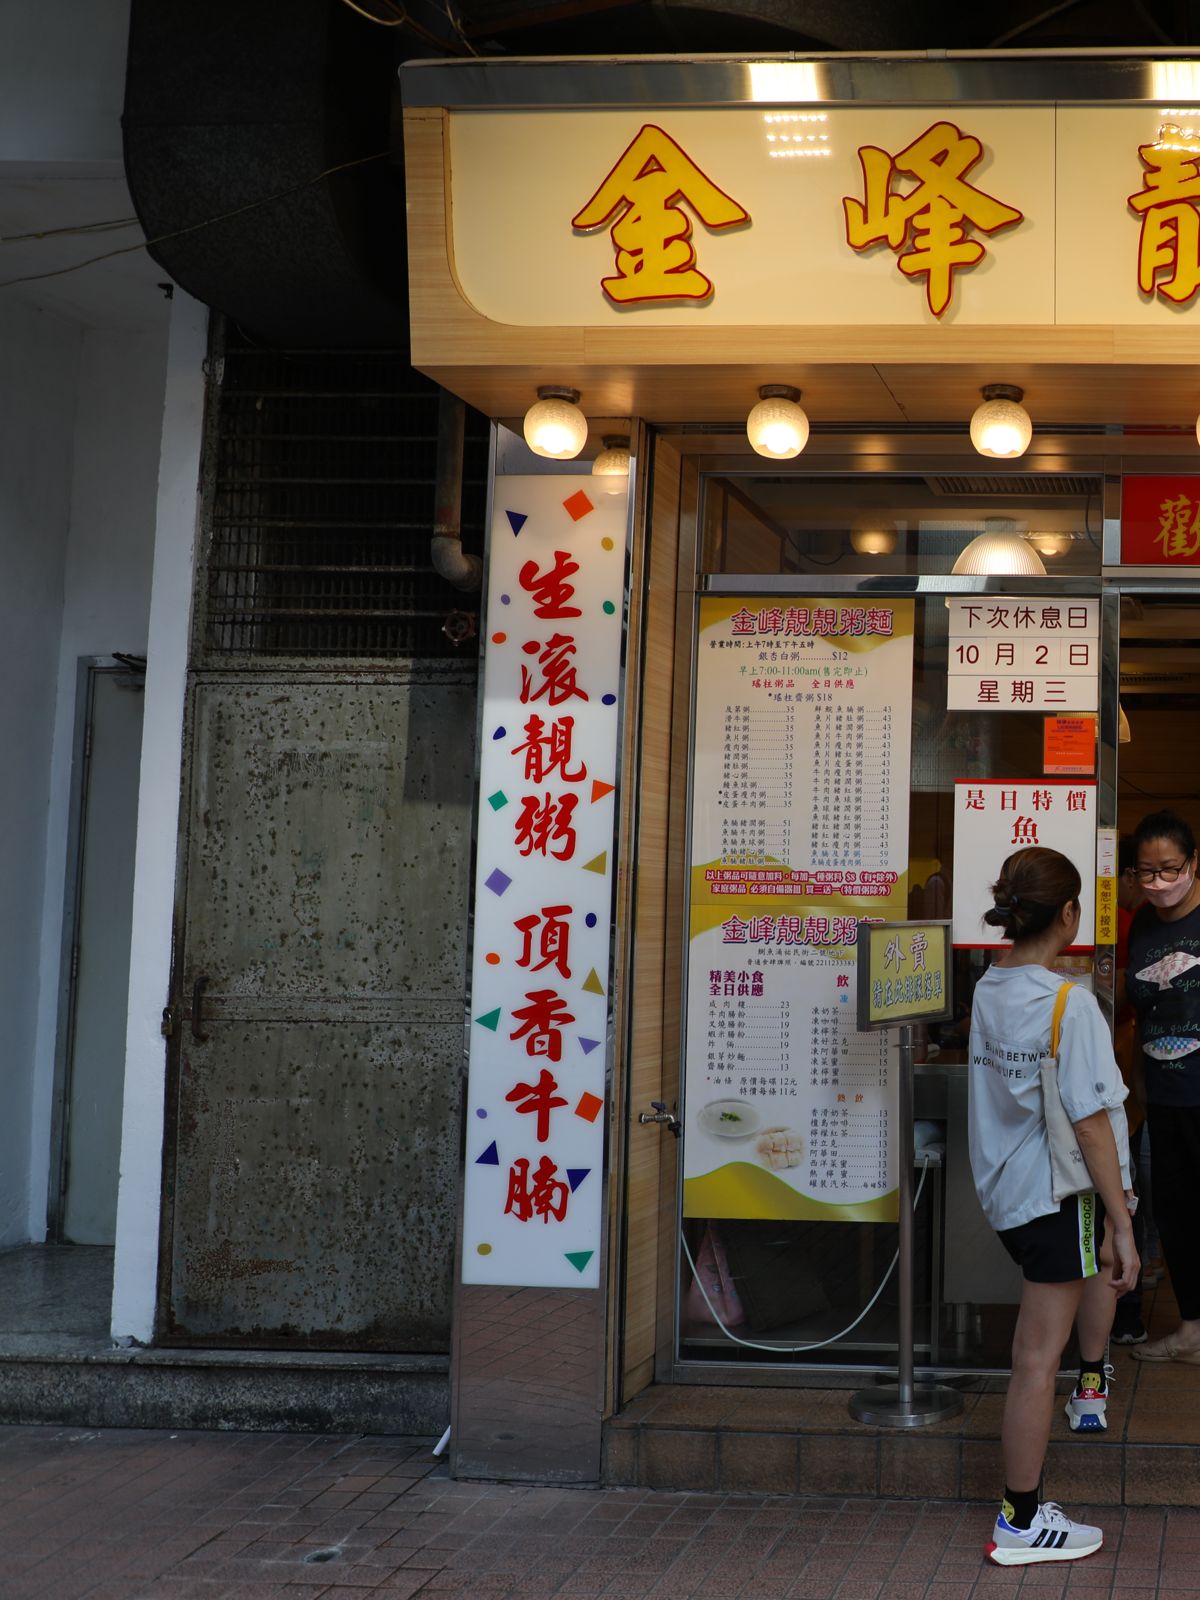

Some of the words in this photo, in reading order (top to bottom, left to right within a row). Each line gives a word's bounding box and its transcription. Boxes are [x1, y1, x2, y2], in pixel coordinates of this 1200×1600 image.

[730, 607, 894, 637] 金峰靚靚粥麵
[960, 605, 1089, 630] 下次休息日
[832, 651, 848, 661] $12
[811, 679, 855, 689] 全日供應
[977, 679, 1067, 704] 星期三
[510, 551, 590, 862] 生滾靚粥
[816, 693, 833, 702] $18
[965, 789, 1087, 812] 是日特價
[1010, 815, 1040, 846] 魚
[722, 914, 885, 945] 金峰靚靚粥
[883, 931, 928, 974] 外賣
[710, 970, 764, 983] 精美小食
[710, 984, 764, 997] 全日供應
[503, 905, 578, 1226] 頂香牛腩
